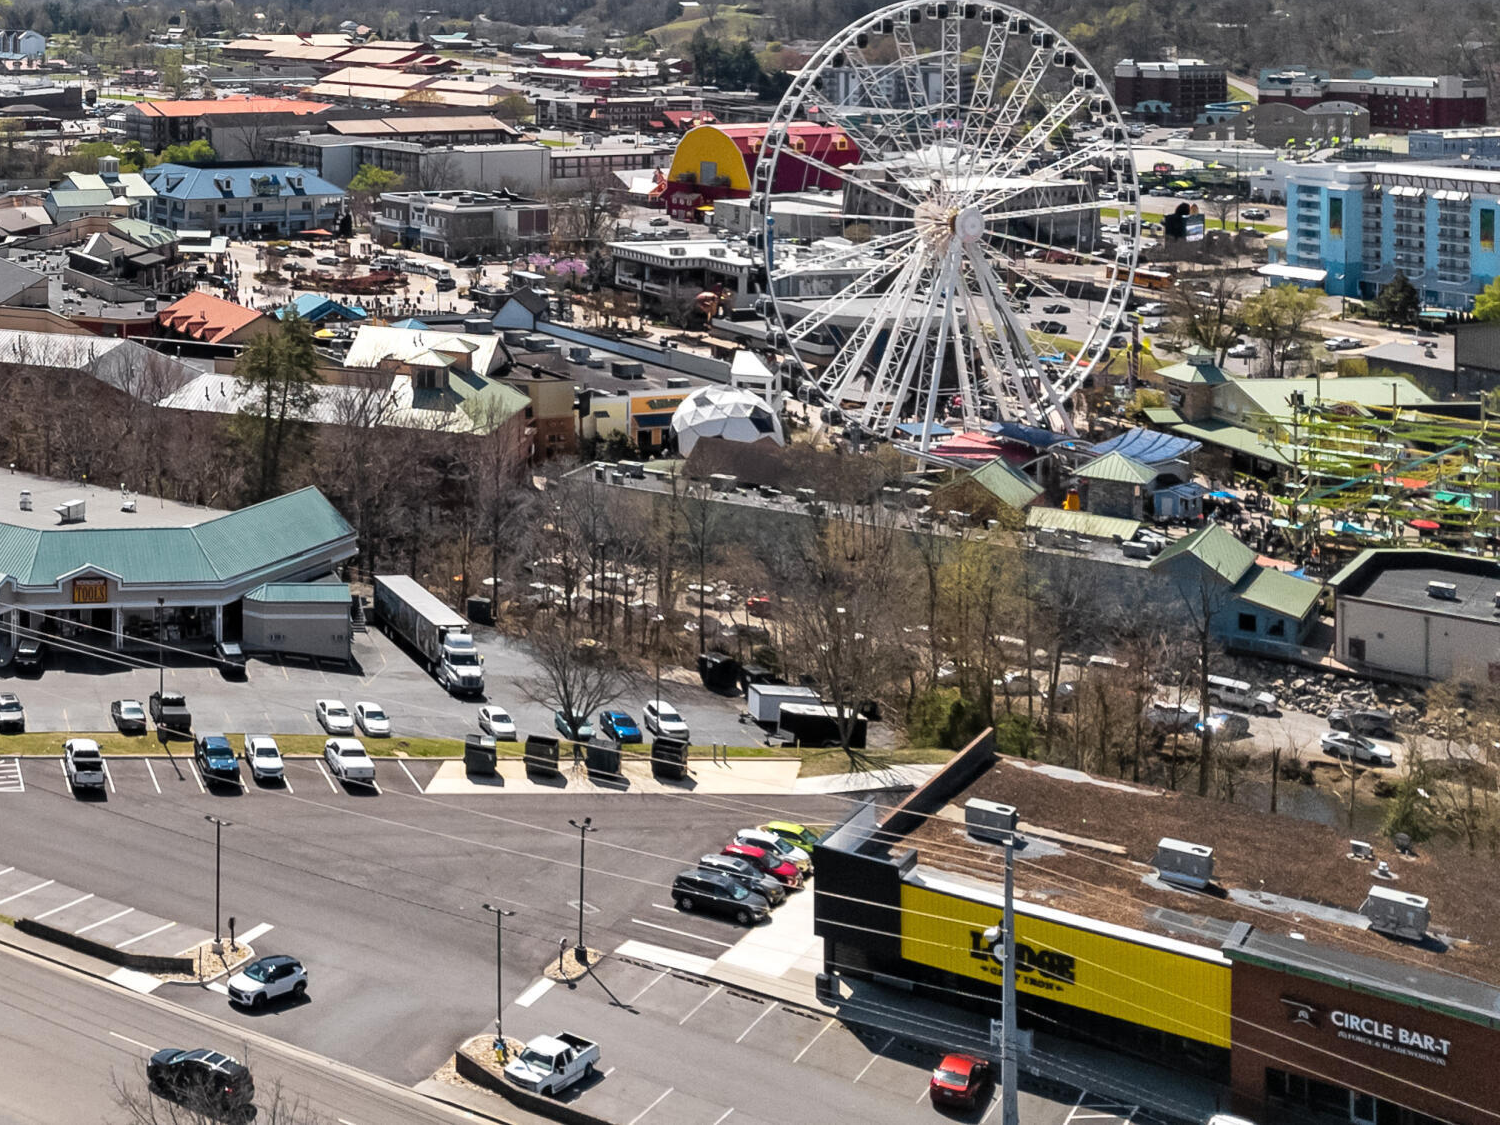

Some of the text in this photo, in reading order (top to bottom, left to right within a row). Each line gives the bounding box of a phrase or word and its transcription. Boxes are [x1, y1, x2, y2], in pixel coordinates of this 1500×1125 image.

[74, 585, 106, 602] TOOLS
[1331, 1011, 1452, 1056] CIRCLE BAR-T
